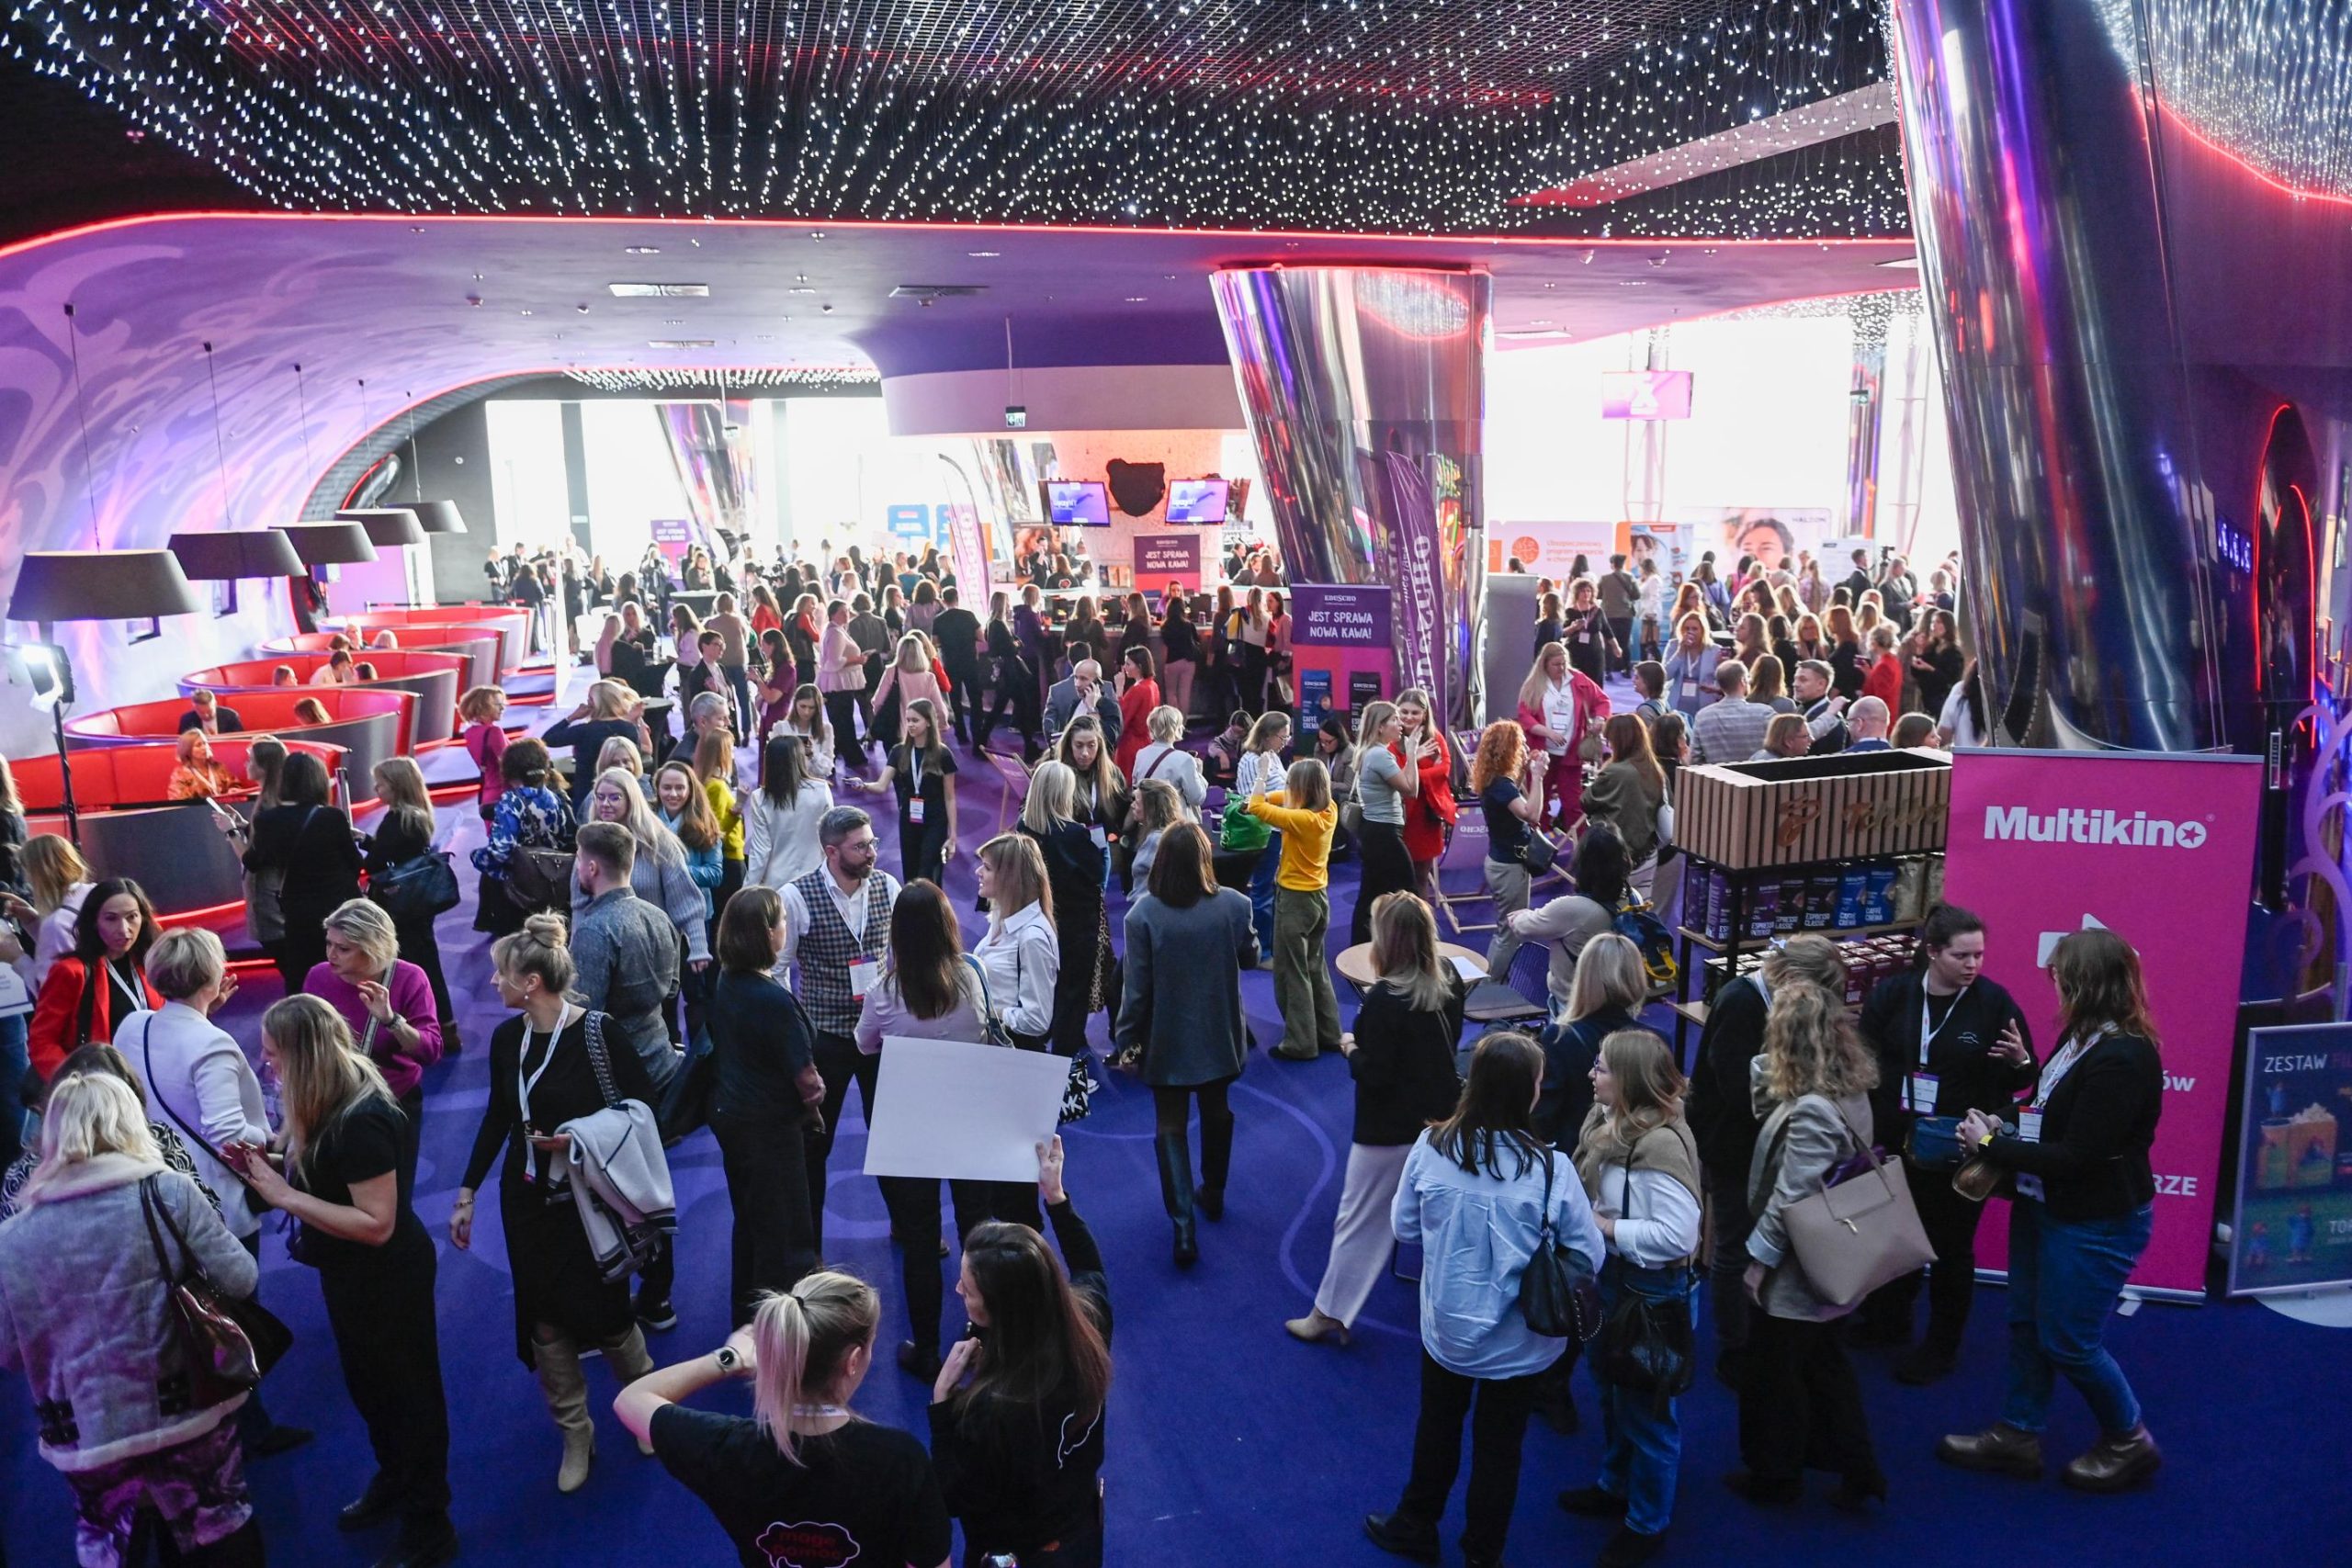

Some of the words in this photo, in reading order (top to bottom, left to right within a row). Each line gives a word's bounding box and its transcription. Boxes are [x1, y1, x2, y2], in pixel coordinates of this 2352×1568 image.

[1324, 594, 1357, 603] EDUSCHO
[1308, 611, 1330, 623] JEST
[1334, 612, 1373, 624] SPRAWA
[1309, 626, 1339, 638] NOWA
[1341, 626, 1372, 638] KAWA!
[1984, 805, 2207, 850] Multikino
[2263, 1054, 2328, 1073] ZESTAW
